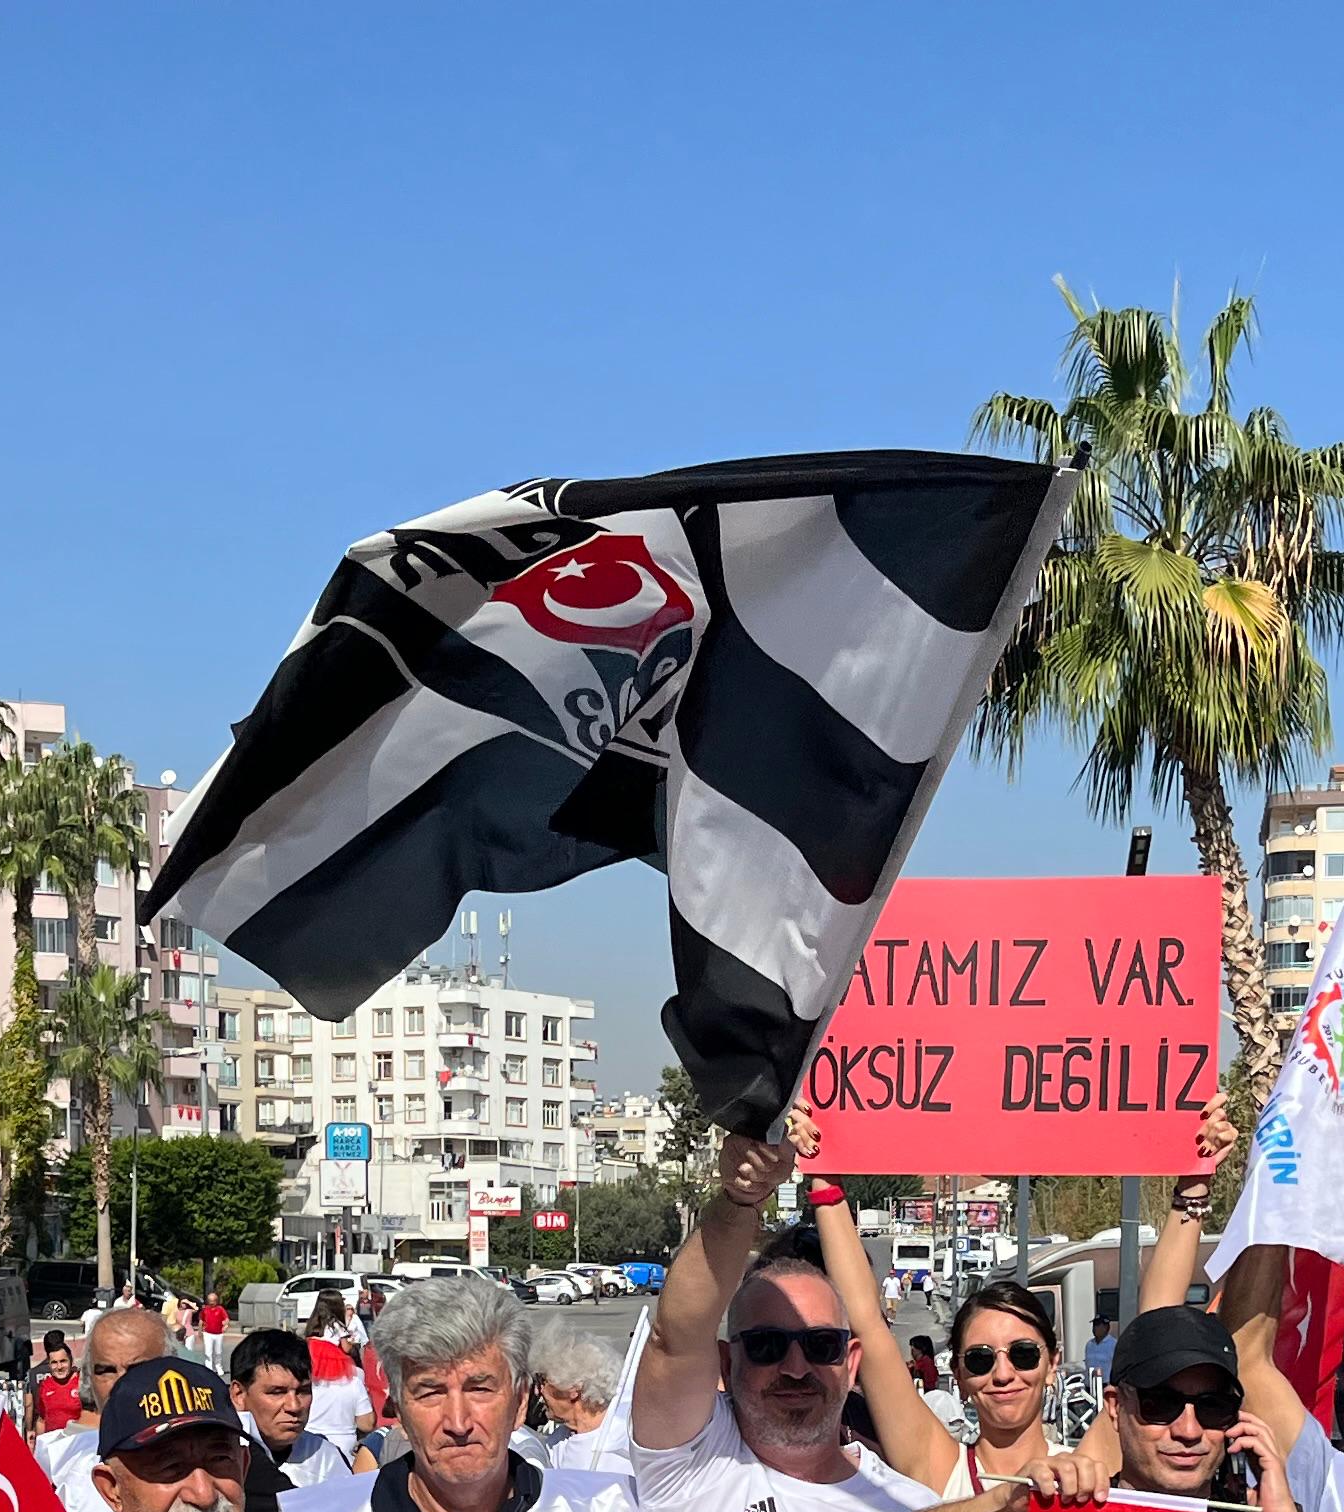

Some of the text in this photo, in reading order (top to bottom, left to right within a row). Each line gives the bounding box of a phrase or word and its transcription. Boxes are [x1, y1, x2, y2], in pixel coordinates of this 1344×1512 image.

[1084, 936, 1195, 1007] VAR.
[809, 1034, 1210, 1113] ÖKSÜZ DEĞİLİZ
[536, 1212, 566, 1228] BİM
[138, 1369, 215, 1419] 18 MART
